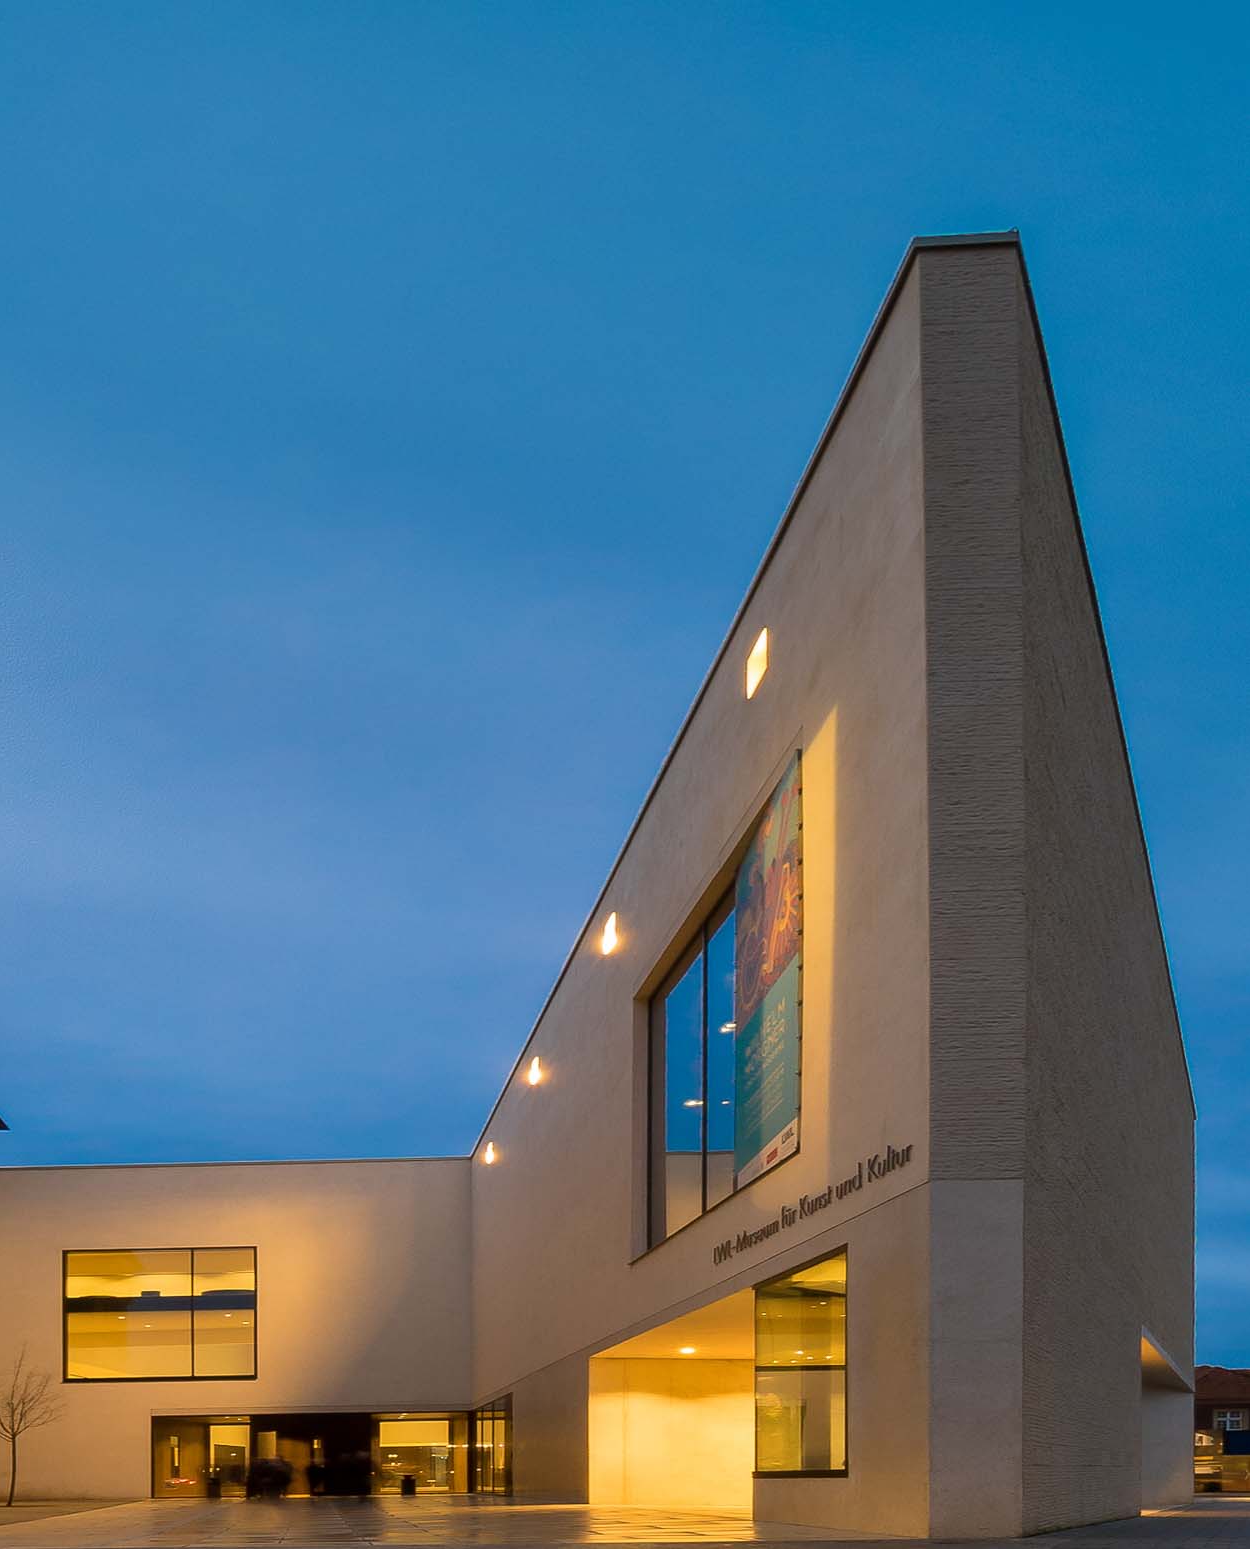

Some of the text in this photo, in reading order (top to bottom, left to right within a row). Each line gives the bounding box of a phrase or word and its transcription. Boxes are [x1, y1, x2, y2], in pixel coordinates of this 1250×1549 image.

[713, 1144, 913, 1266] LWL-Museum für Kunst und Kultur
